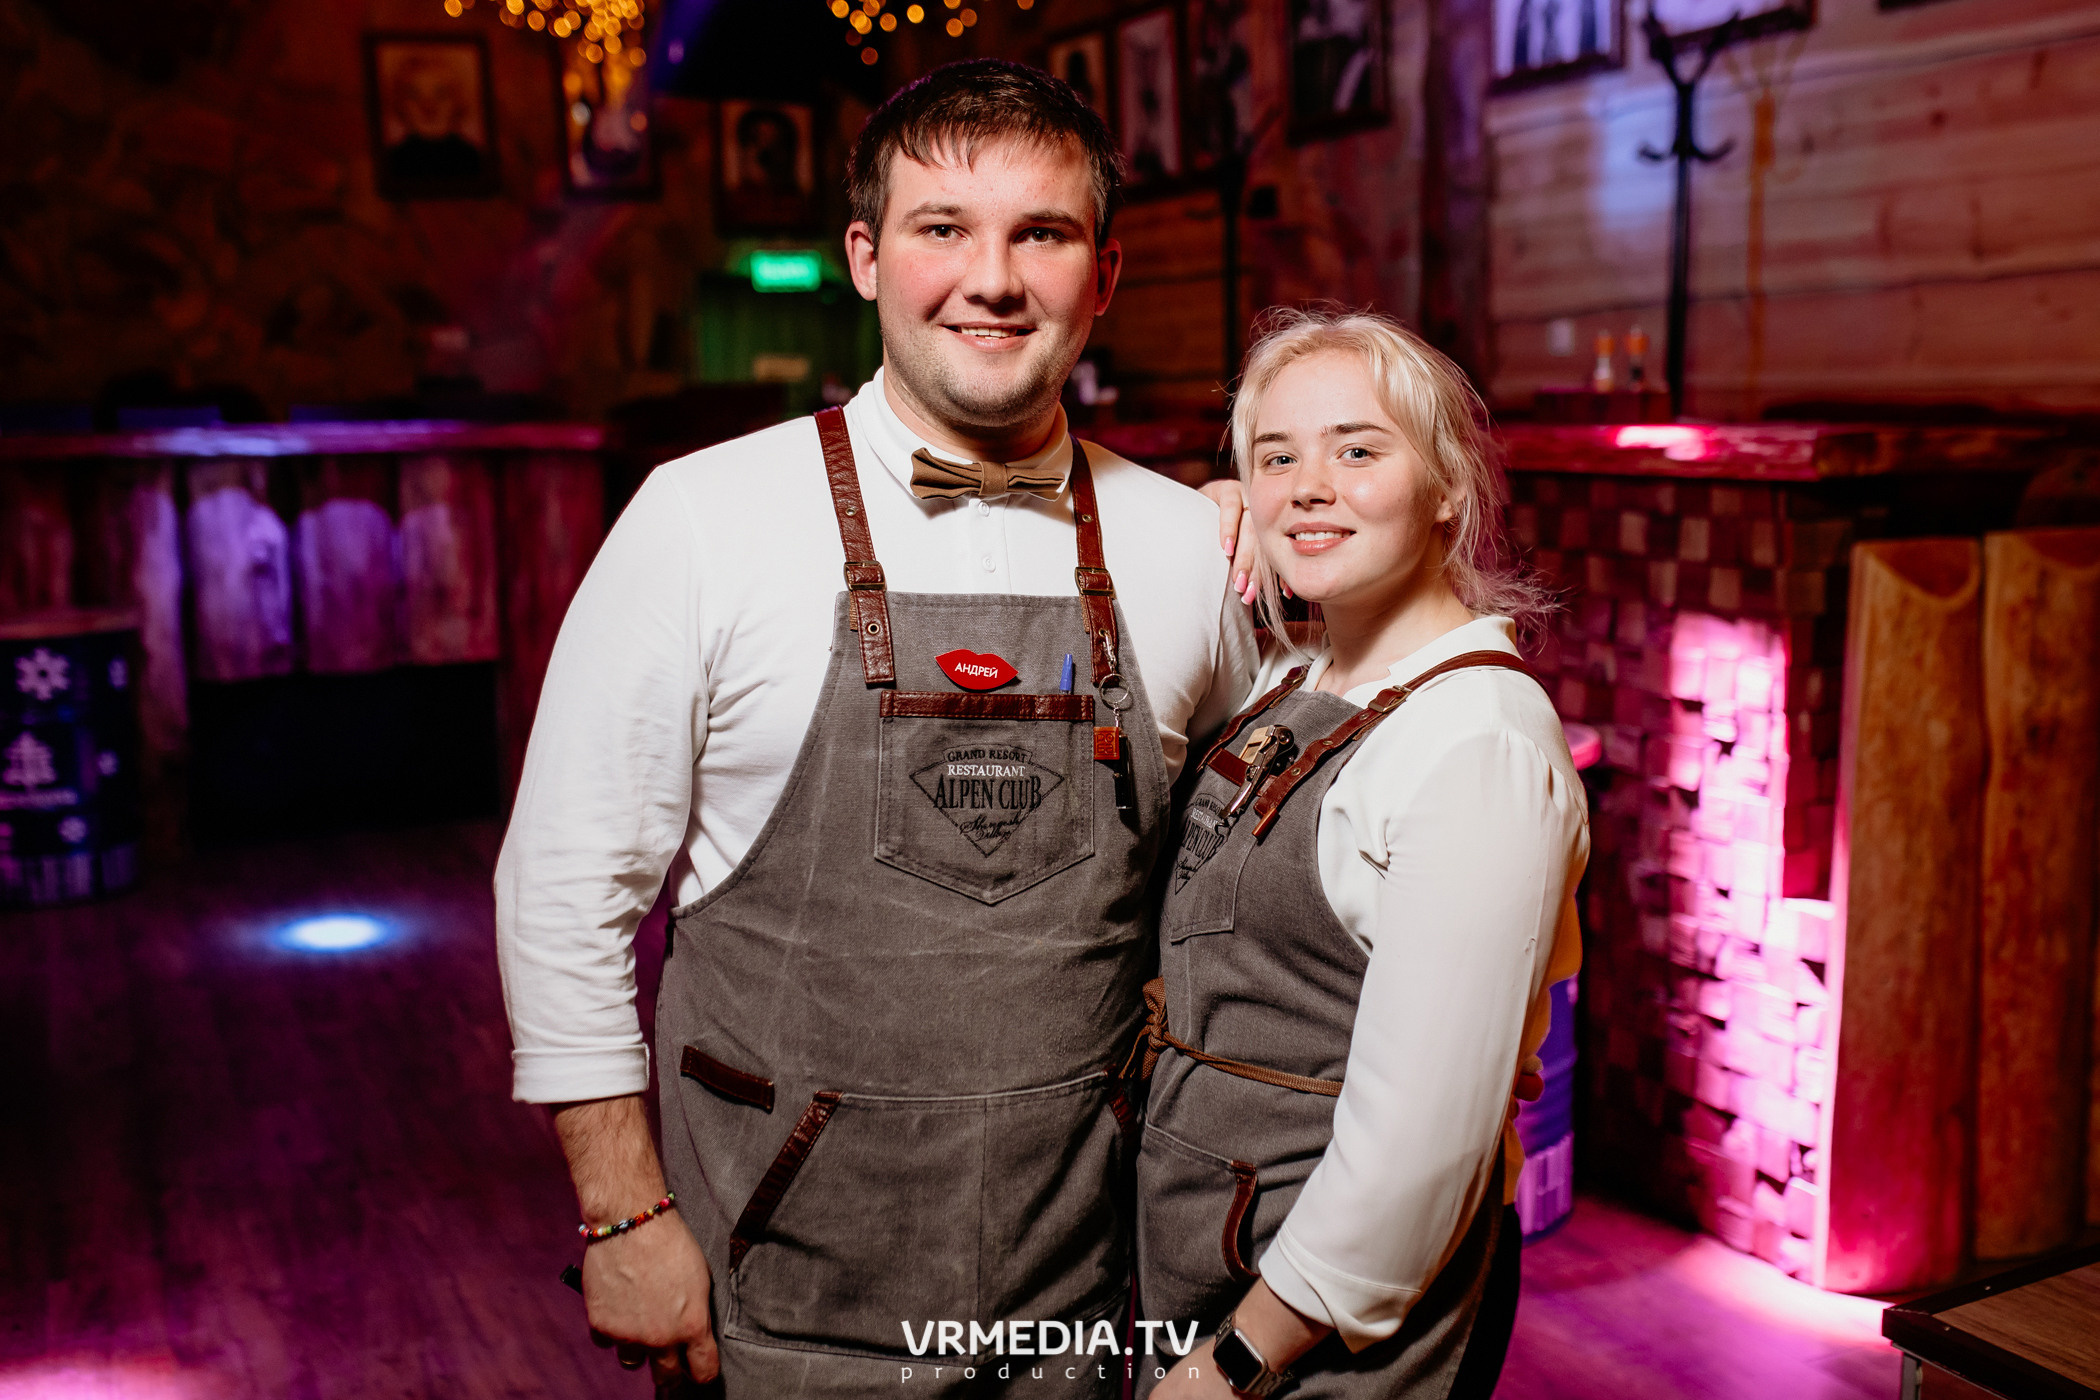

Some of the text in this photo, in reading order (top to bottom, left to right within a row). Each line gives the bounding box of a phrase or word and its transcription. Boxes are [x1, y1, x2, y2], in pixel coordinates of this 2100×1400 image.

[954, 662, 999, 679] АНДРЕЙ
[947, 749, 1028, 764] GRAND RESORT
[947, 764, 1026, 777] RESTAURANT
[932, 772, 1042, 810] ALPEN CLUB
